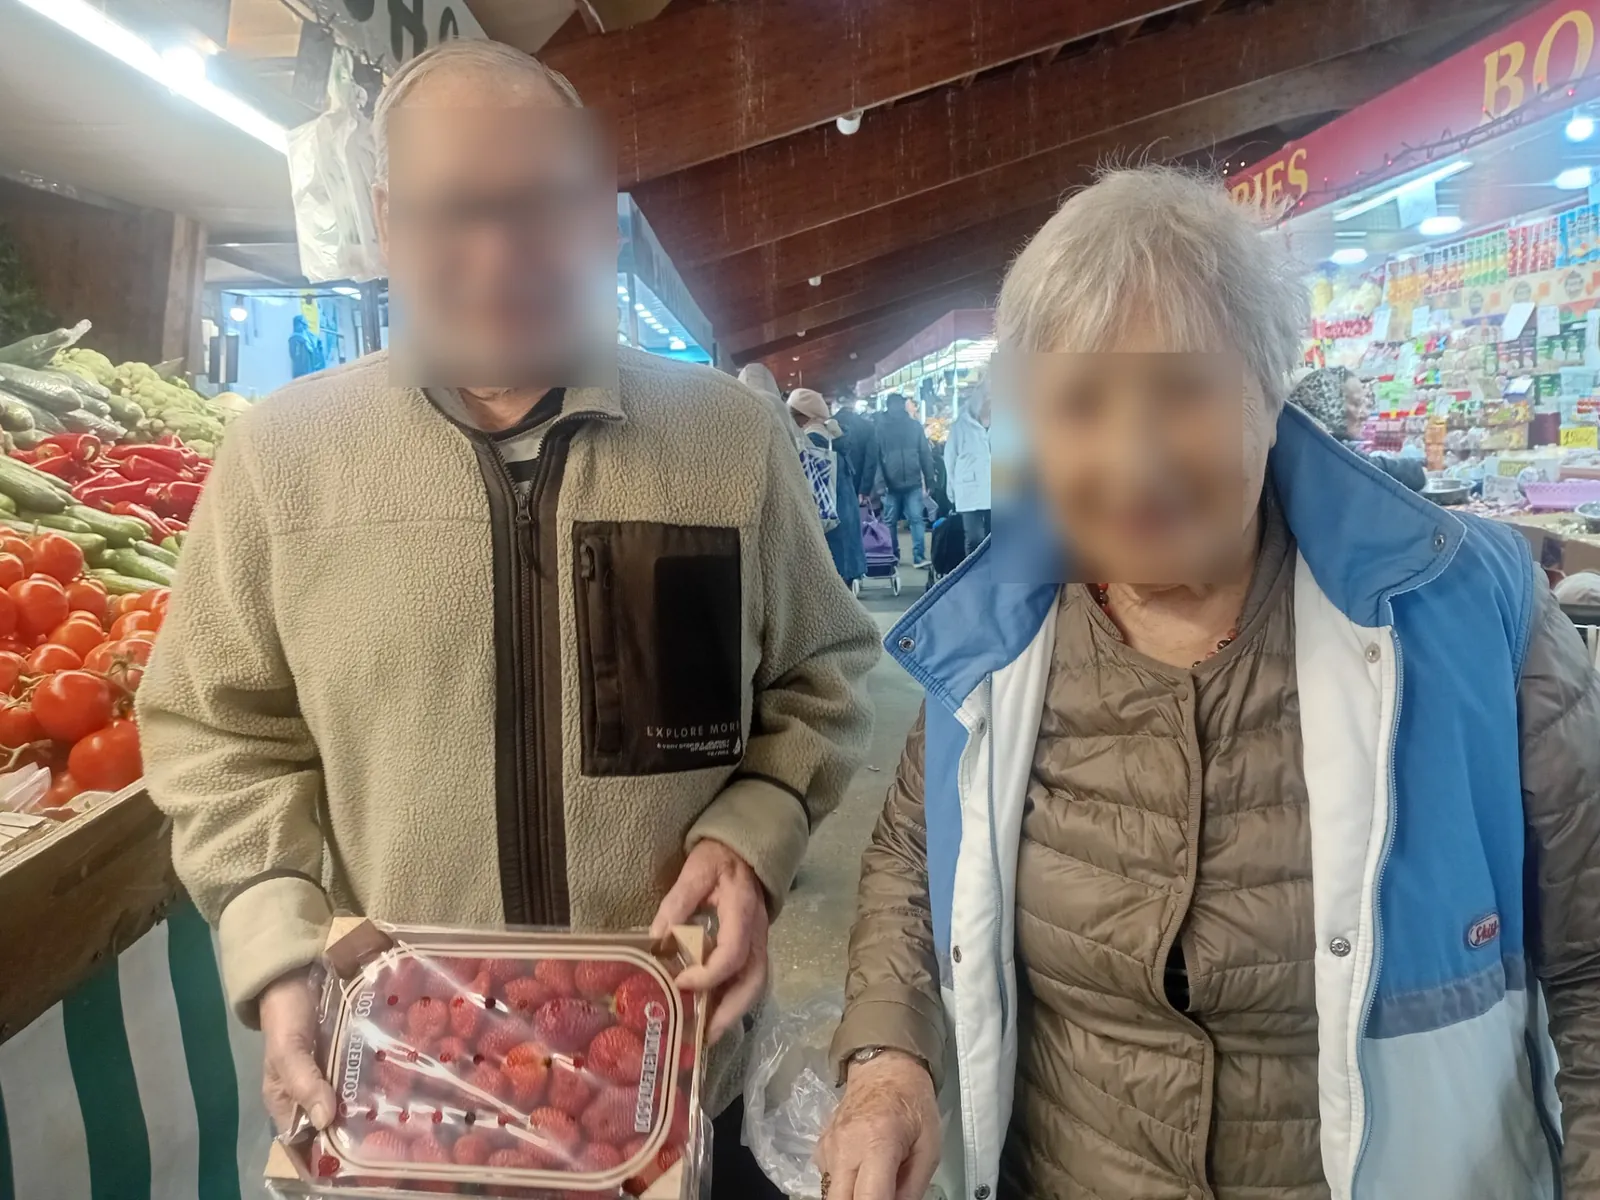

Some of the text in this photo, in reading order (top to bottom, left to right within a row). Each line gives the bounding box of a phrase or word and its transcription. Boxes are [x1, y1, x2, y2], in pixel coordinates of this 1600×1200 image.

[1479, 9, 1594, 124] BO
[646, 720, 740, 738] EXPLORE MOR
[355, 991, 376, 1017] LOS
